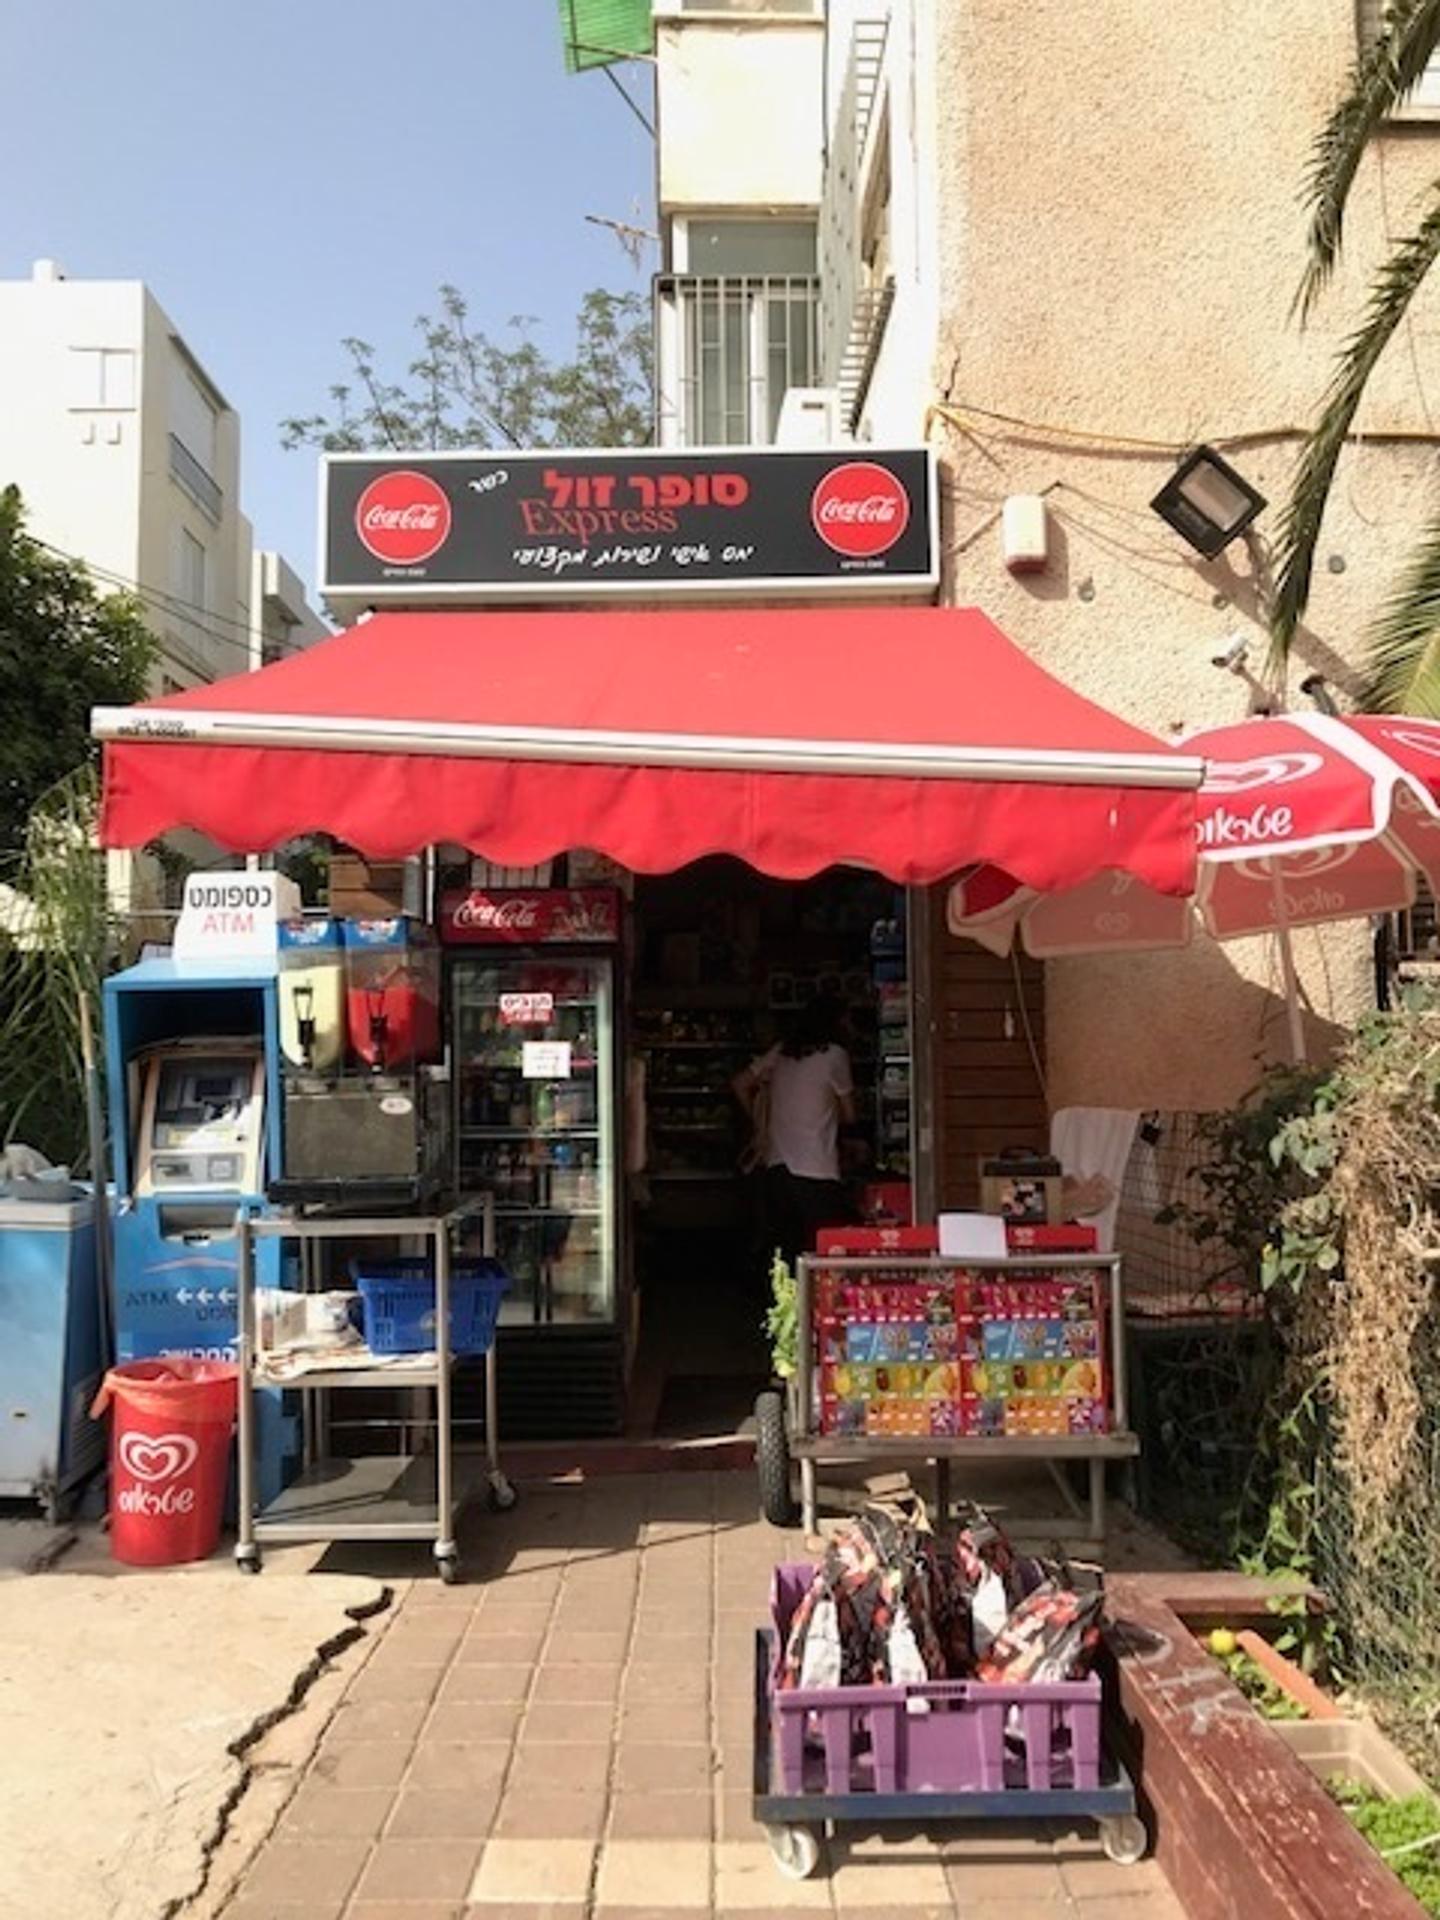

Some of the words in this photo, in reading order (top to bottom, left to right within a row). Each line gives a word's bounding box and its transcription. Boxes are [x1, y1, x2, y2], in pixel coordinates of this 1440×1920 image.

[468, 470, 508, 493] כשר
[542, 467, 617, 509] זול
[628, 473, 749, 508] סופר
[519, 498, 680, 545] Express
[591, 545, 662, 568] ושירות
[670, 544, 710, 564] אישי
[189, 885, 272, 909] כספומט
[203, 912, 254, 933] ATM
